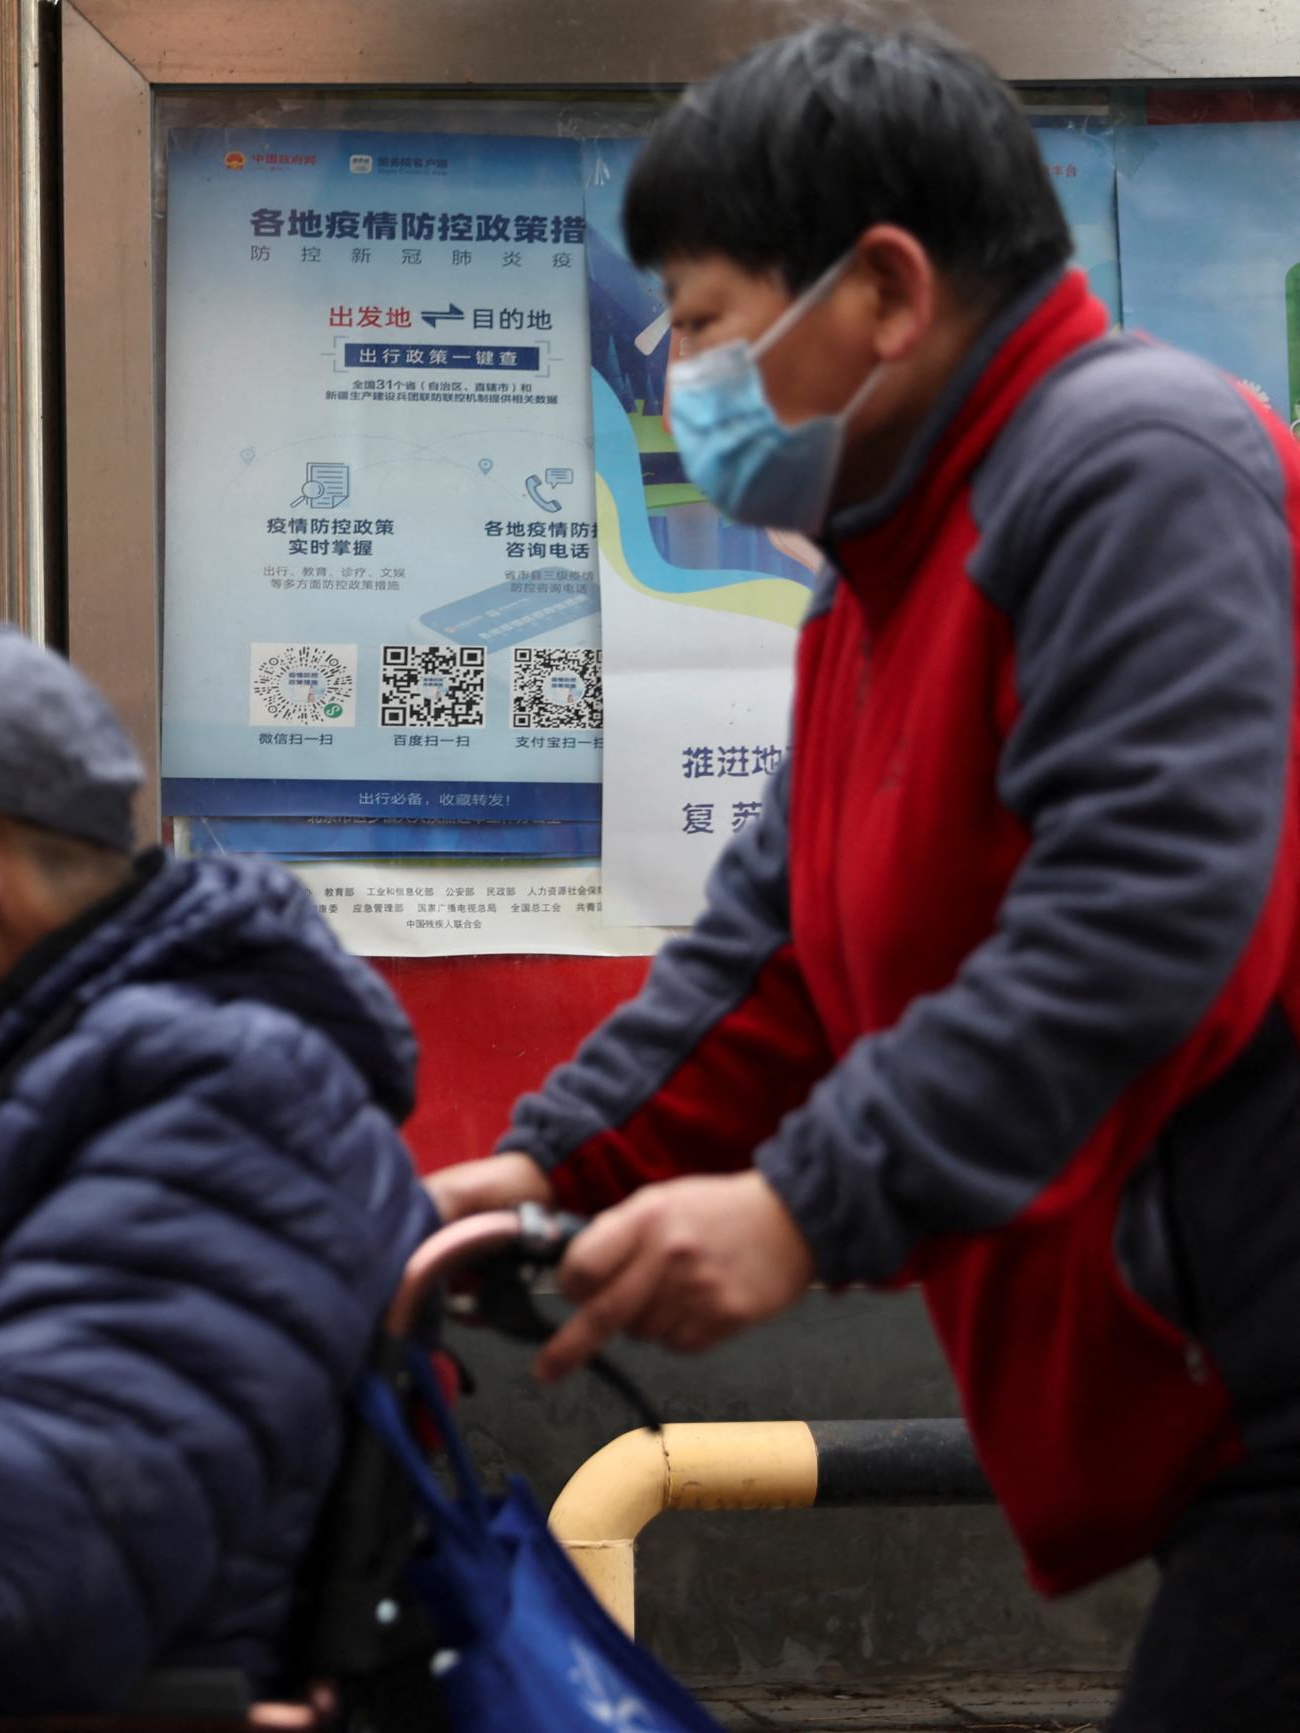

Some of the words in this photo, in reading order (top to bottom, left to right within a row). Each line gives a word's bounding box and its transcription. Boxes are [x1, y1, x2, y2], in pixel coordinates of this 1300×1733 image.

[250, 208, 586, 244] 各地疫情防控政策措
[251, 245, 572, 268] 防控新冠肺炎疫
[330, 306, 411, 328] 出发地
[474, 308, 552, 330] 目的地
[358, 348, 518, 368] 出行政策一键查
[267, 518, 394, 535] 疫情防控政策
[289, 539, 372, 556] 实时掌握
[506, 542, 590, 559] 咨询电话
[271, 576, 401, 590] 等多方面防控政策措施
[259, 733, 332, 745] 微信扫一扫
[394, 735, 469, 747] 百度扫一扫
[682, 745, 790, 778] 推进地
[325, 888, 354, 897] 教育部
[446, 887, 475, 896] 公安部
[487, 887, 515, 896] 民政部
[353, 904, 403, 913] 应急管理部
[511, 903, 561, 912] 全国总工会
